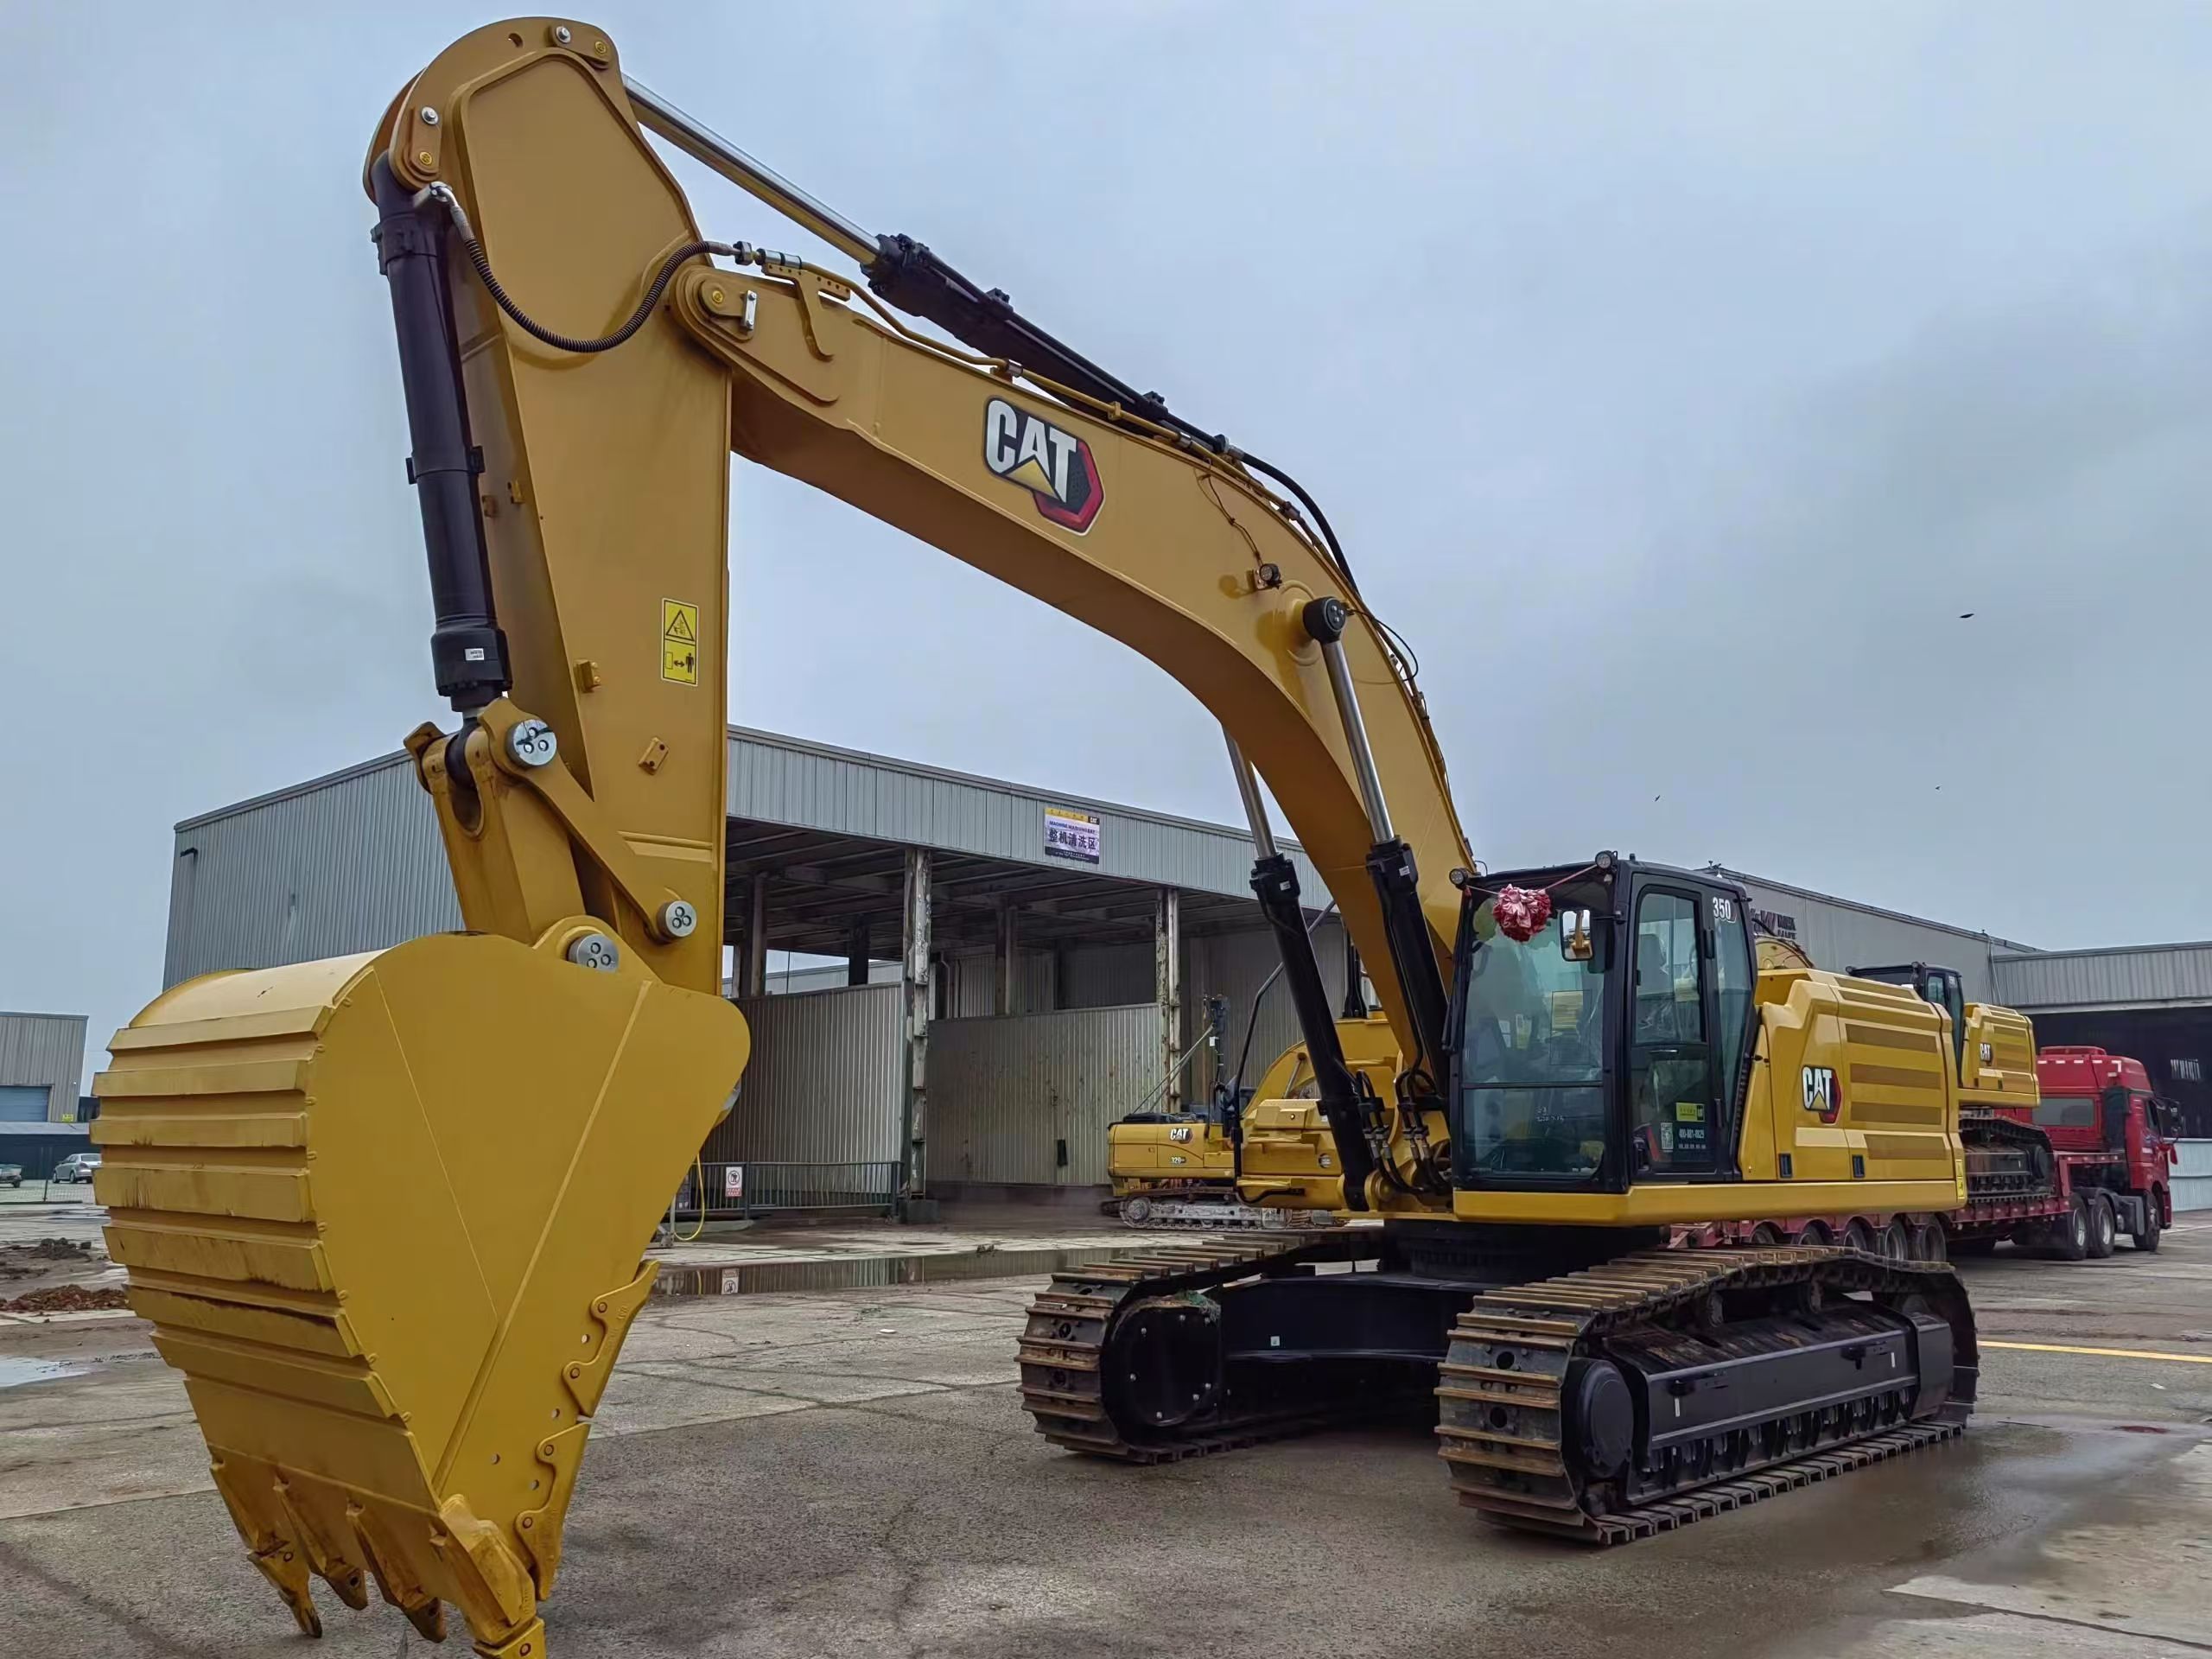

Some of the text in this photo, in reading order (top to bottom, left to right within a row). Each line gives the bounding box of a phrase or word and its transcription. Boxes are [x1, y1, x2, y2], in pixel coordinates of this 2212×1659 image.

[986, 399, 1077, 503] CAT
[1049, 828, 1096, 849] 整机清洗区
[1713, 897, 1731, 919] 350
[1980, 1043, 1991, 1061] CAT
[1802, 1066, 1832, 1110] CAT
[1170, 1128, 1189, 1141] CAT
